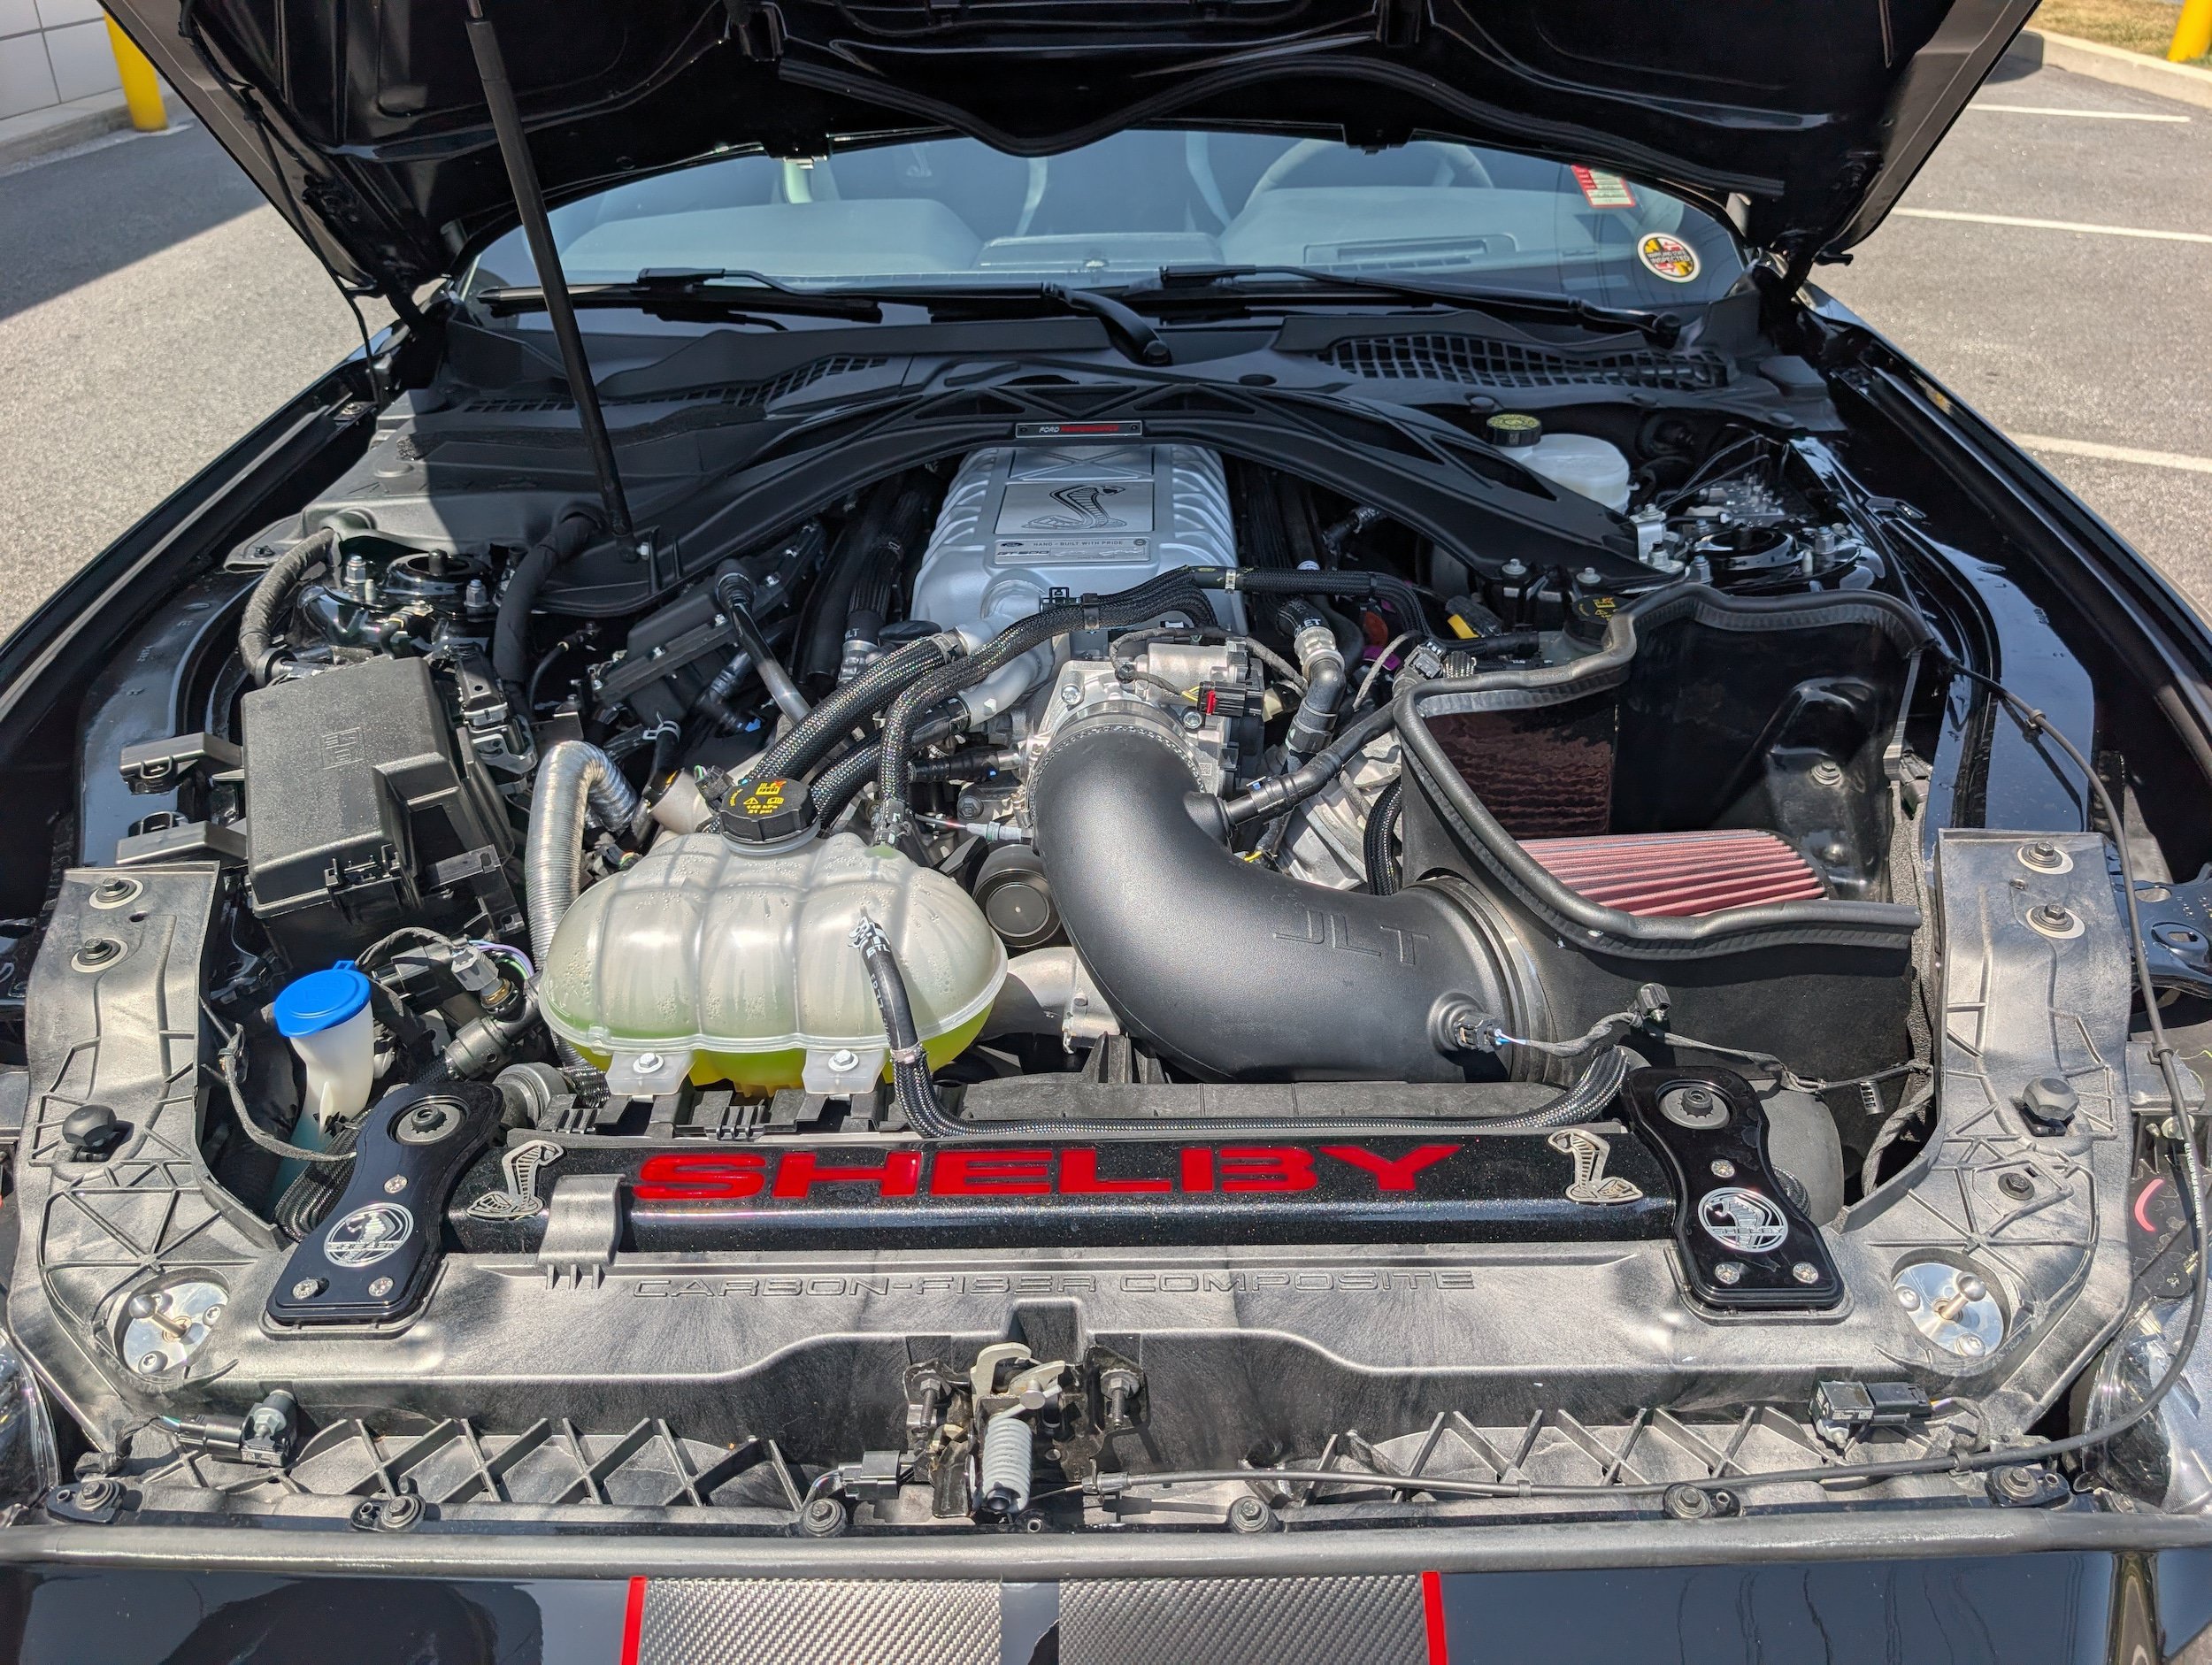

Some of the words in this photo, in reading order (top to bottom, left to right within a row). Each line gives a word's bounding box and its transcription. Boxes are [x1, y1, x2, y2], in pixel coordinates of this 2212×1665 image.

[1272, 909, 1430, 965] JLT
[632, 1144, 1461, 1201] SHELBY
[634, 1274, 1097, 1298] CARBON-FIBER
[1120, 1270, 1475, 1293] COMPOSITE
